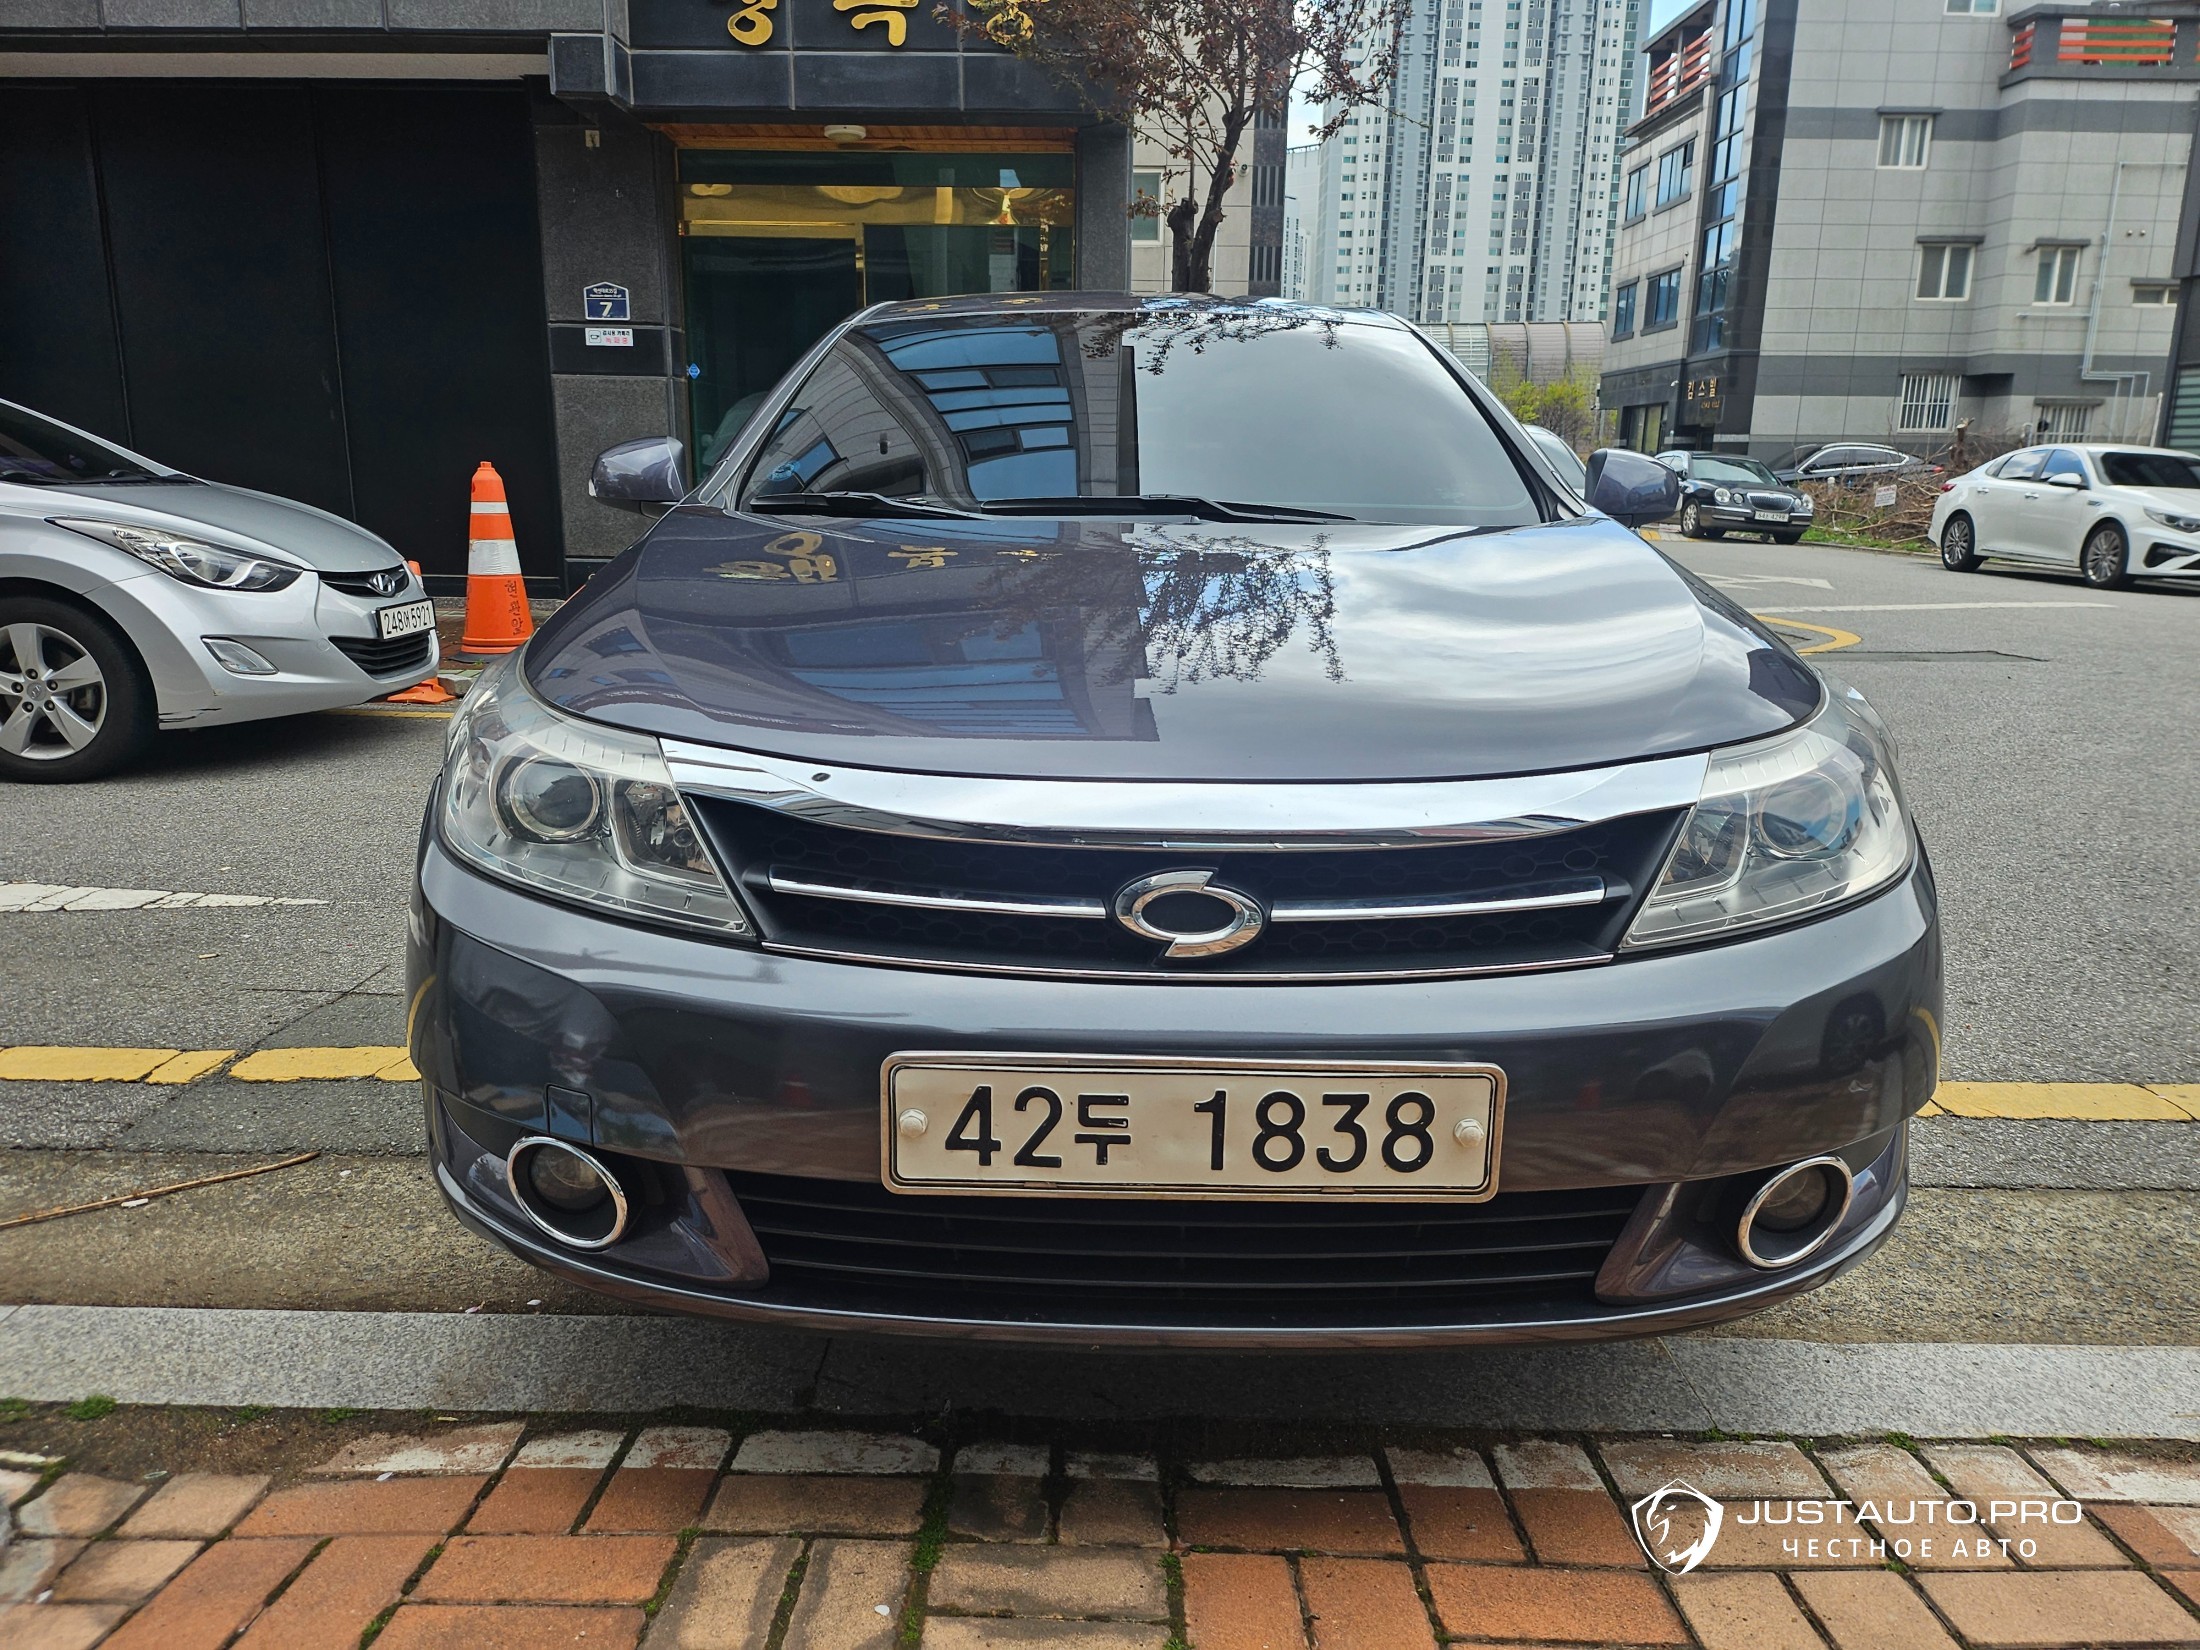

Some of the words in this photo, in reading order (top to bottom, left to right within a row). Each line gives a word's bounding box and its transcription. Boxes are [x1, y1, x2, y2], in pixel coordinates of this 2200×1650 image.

[599, 301, 613, 317] 7
[944, 1085, 1132, 1169] 42두
[1193, 1089, 1436, 1173] 1838
